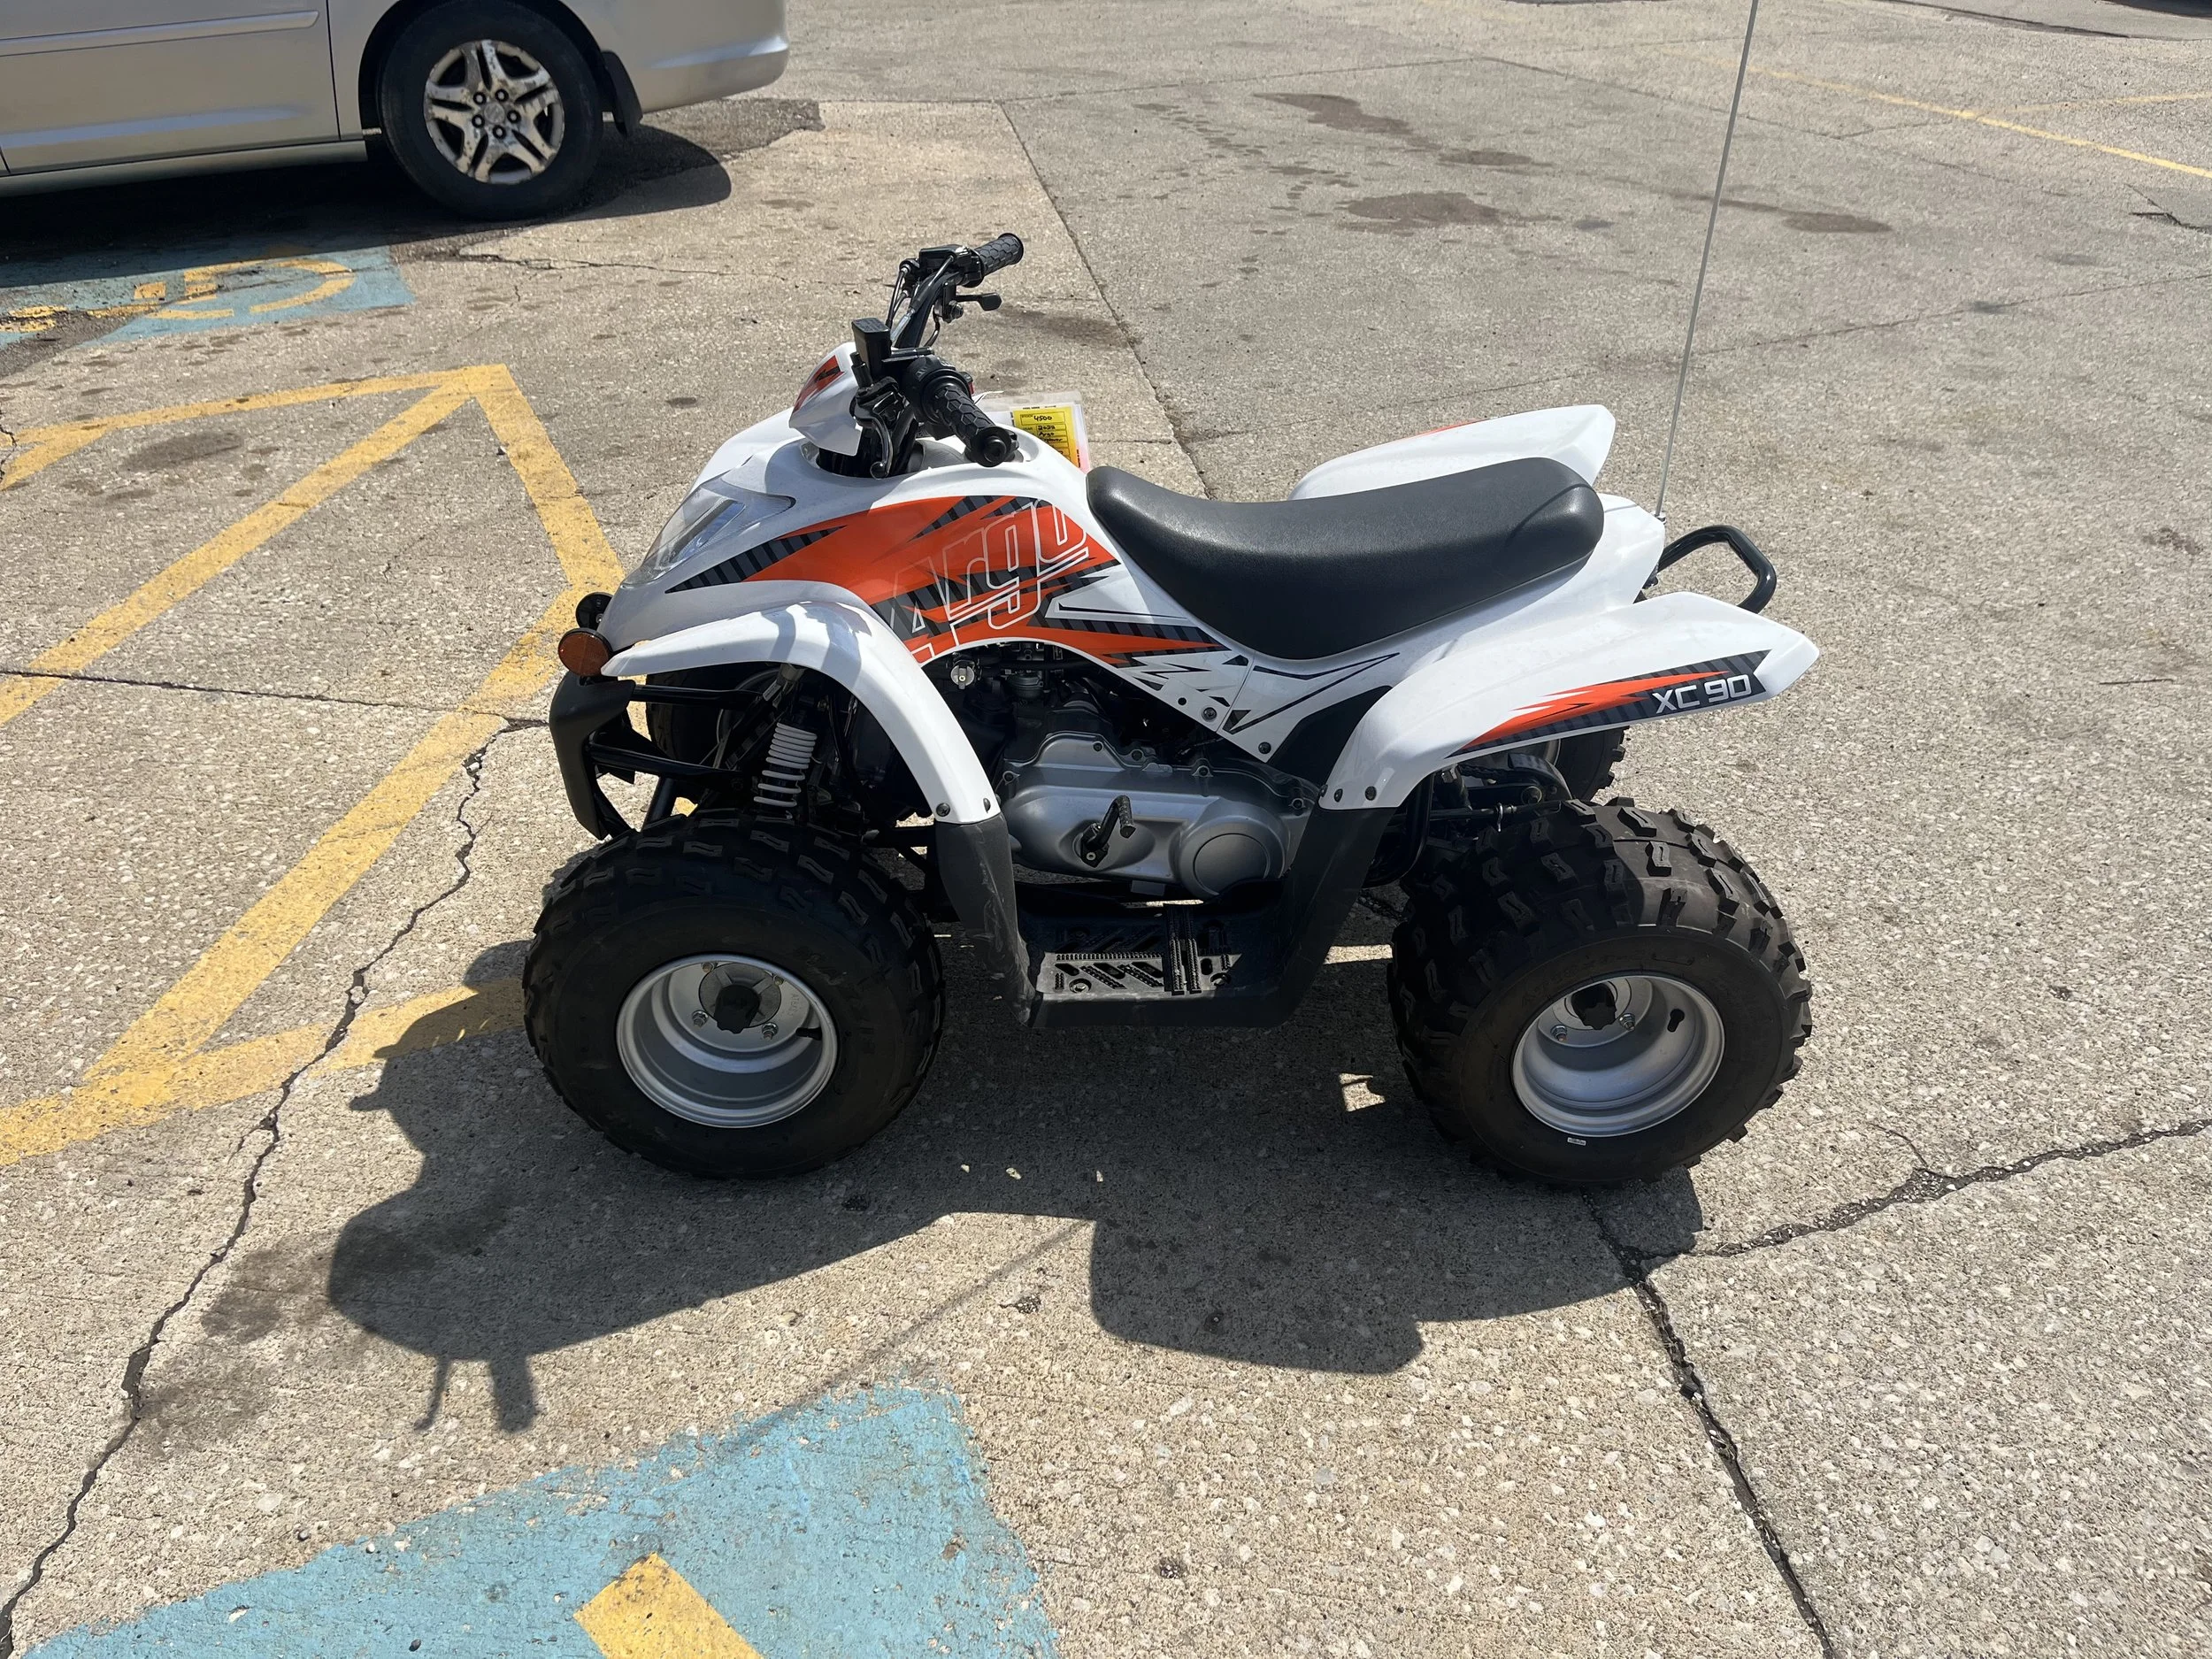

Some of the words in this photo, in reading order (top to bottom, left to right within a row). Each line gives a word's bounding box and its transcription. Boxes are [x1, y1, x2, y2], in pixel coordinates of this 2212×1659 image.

[890, 499, 1089, 665] Argo
[1652, 684, 1701, 714] XC
[1704, 674, 1752, 703] 90
